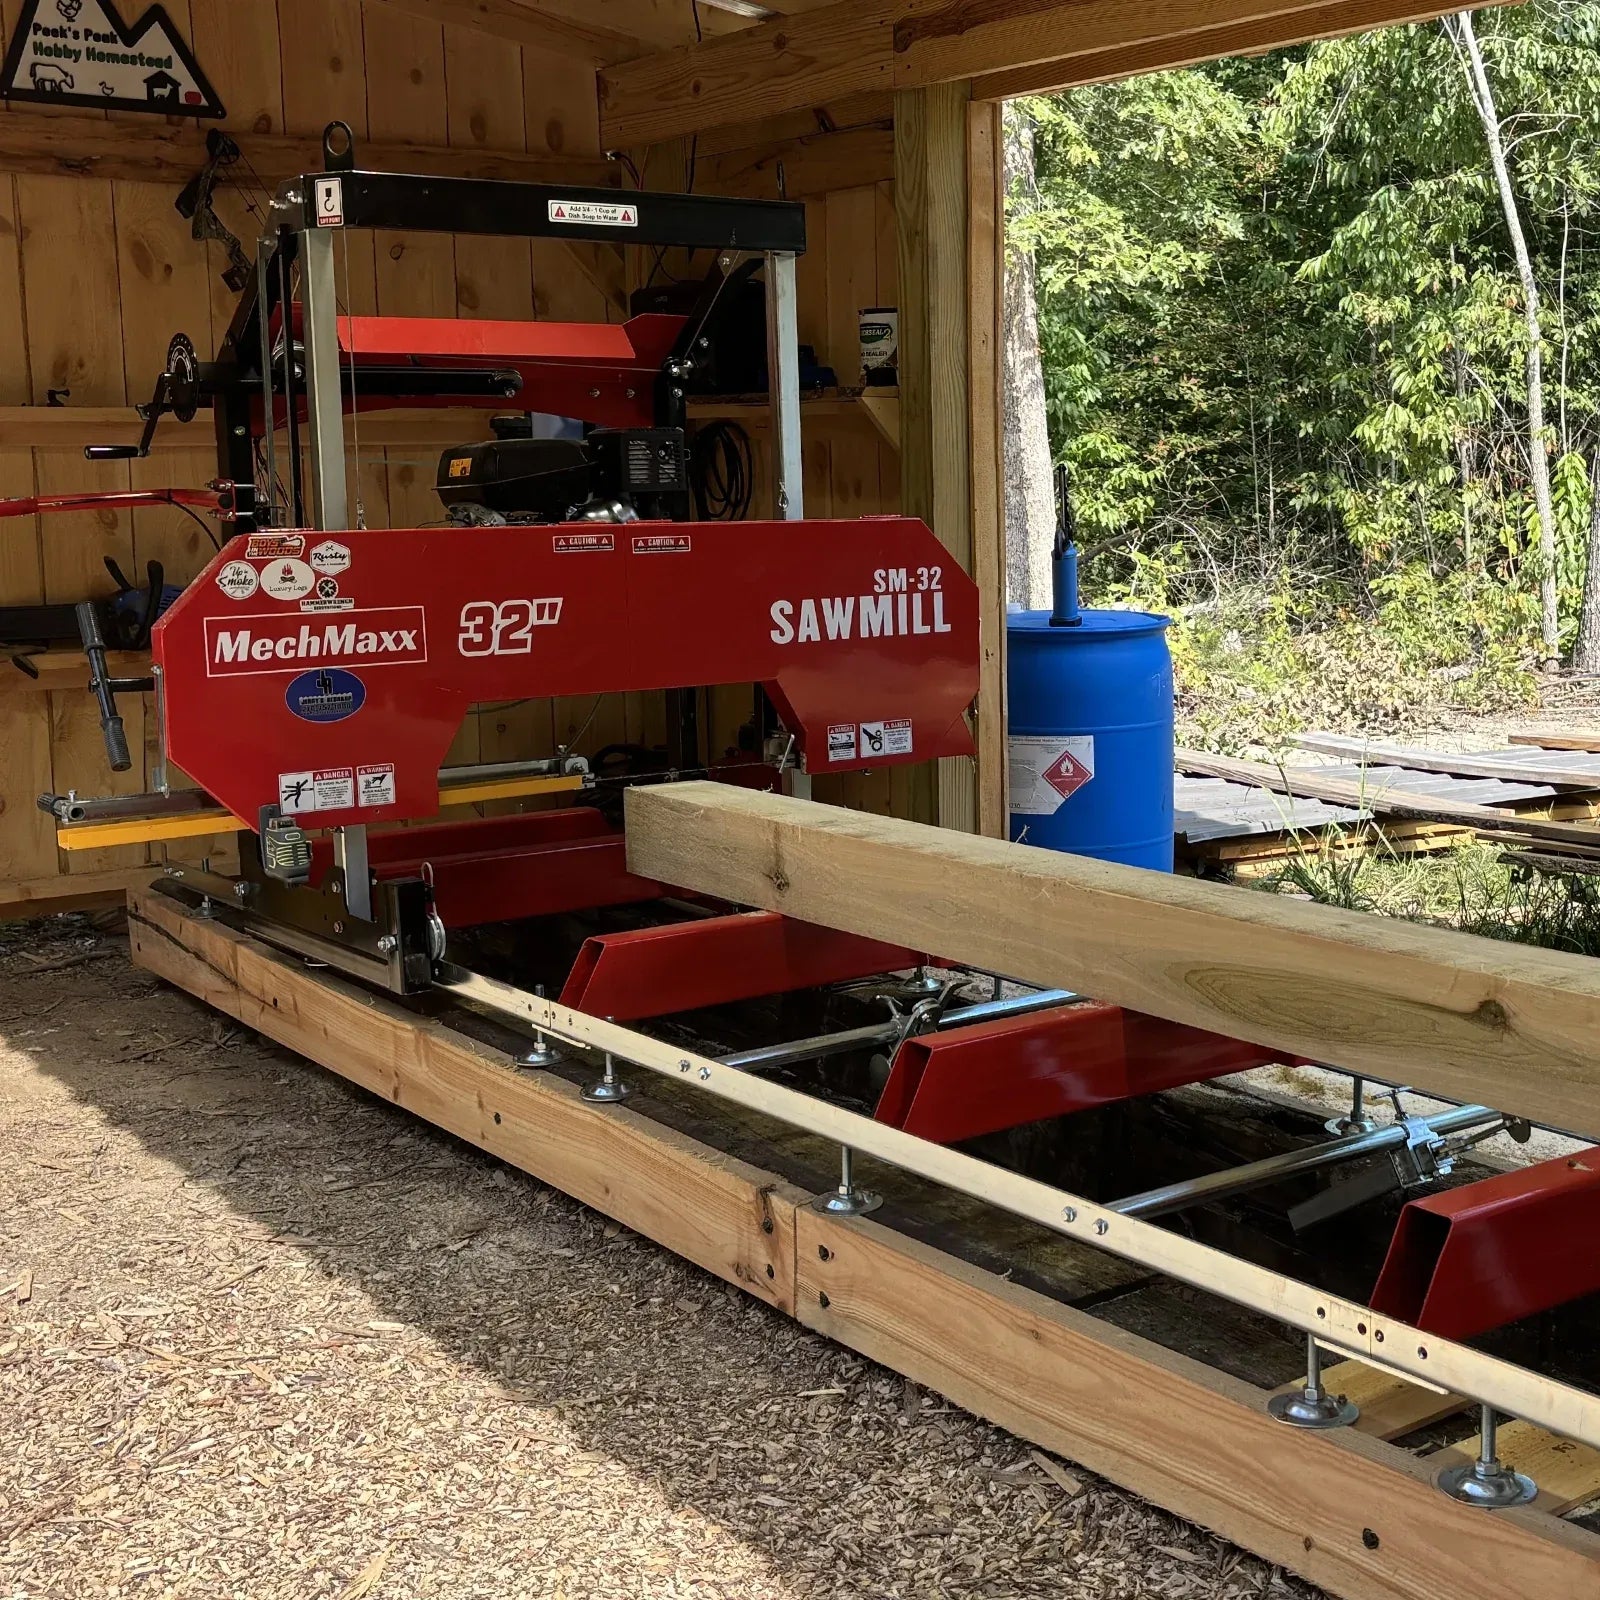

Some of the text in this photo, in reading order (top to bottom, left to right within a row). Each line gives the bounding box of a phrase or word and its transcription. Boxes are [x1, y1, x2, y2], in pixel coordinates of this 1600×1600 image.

[33, 41, 172, 69] Hobby Homestead
[251, 537, 279, 547] BOYS
[569, 537, 597, 545] CAUTION
[648, 538, 675, 546] CAUTION
[259, 546, 301, 556] WOODS
[312, 551, 347, 562] Rusty
[230, 566, 243, 577] Up
[218, 575, 254, 587] Smoke
[873, 566, 942, 593] SM-32
[269, 585, 292, 593] Luxury
[770, 592, 951, 645] SAWMILL
[458, 598, 563, 657] 32"
[214, 623, 418, 663] MechMaxx
[323, 770, 350, 780] DANGER
[366, 766, 392, 774] WARNING
